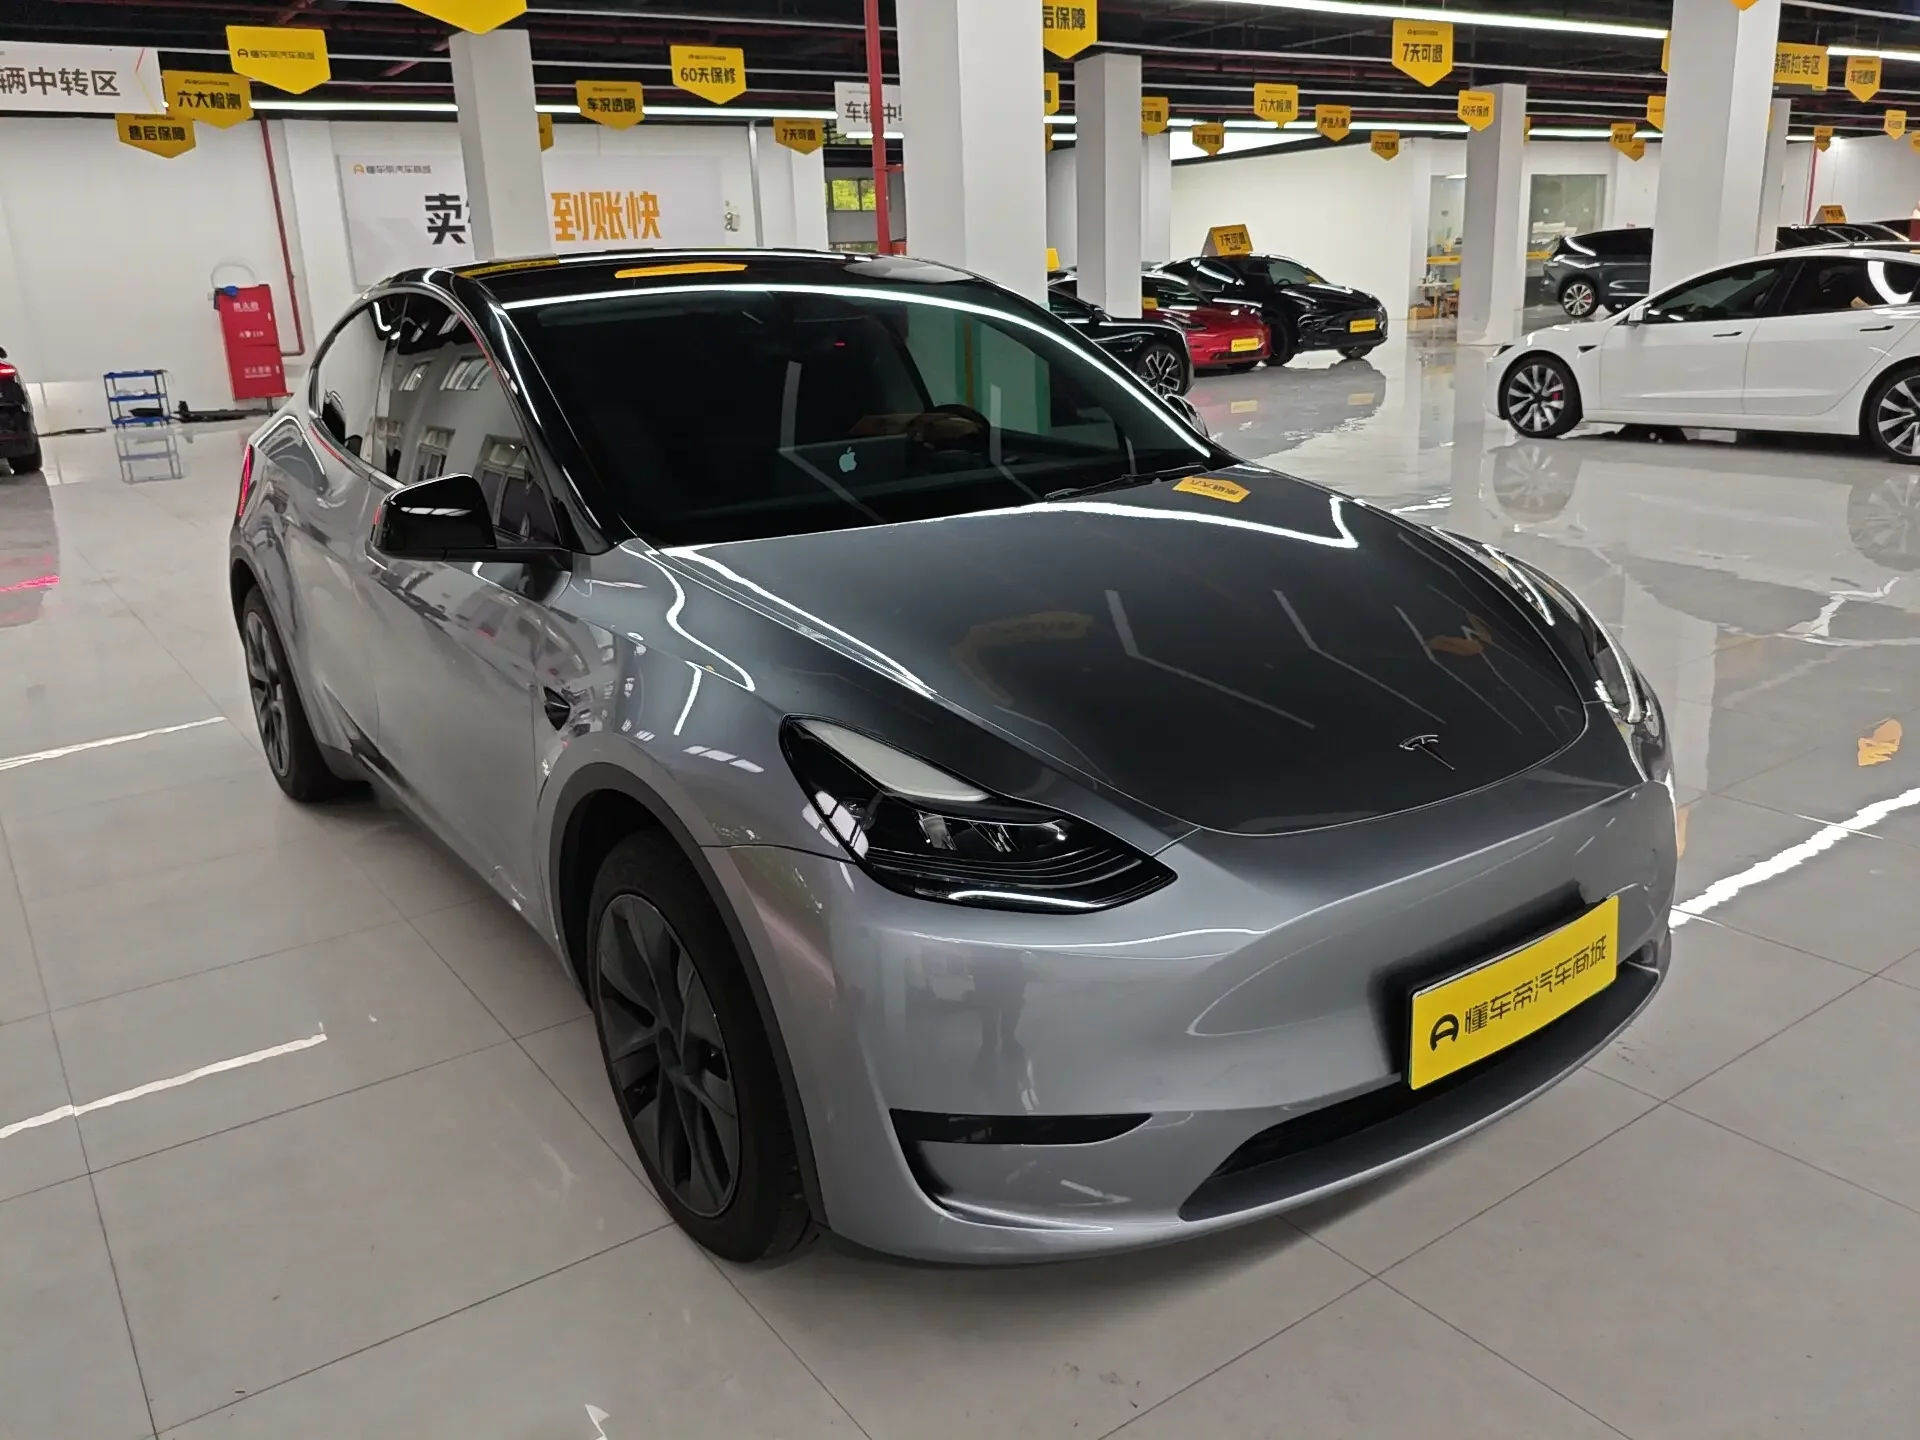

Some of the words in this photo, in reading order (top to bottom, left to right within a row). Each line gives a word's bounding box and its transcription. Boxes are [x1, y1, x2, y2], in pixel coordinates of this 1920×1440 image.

[1402, 42, 1443, 64] 7天可退
[0, 66, 121, 97] 辆中转区
[680, 67, 737, 85] 60天保修
[177, 90, 242, 111] 六大检测
[586, 96, 637, 114] 车况透明
[1259, 98, 1292, 113] 六大检测
[128, 124, 187, 142] 售后保障
[425, 193, 472, 245] 卖
[551, 191, 662, 242] 到账快
[1464, 934, 1608, 1034] 懂车帝汽车商城
